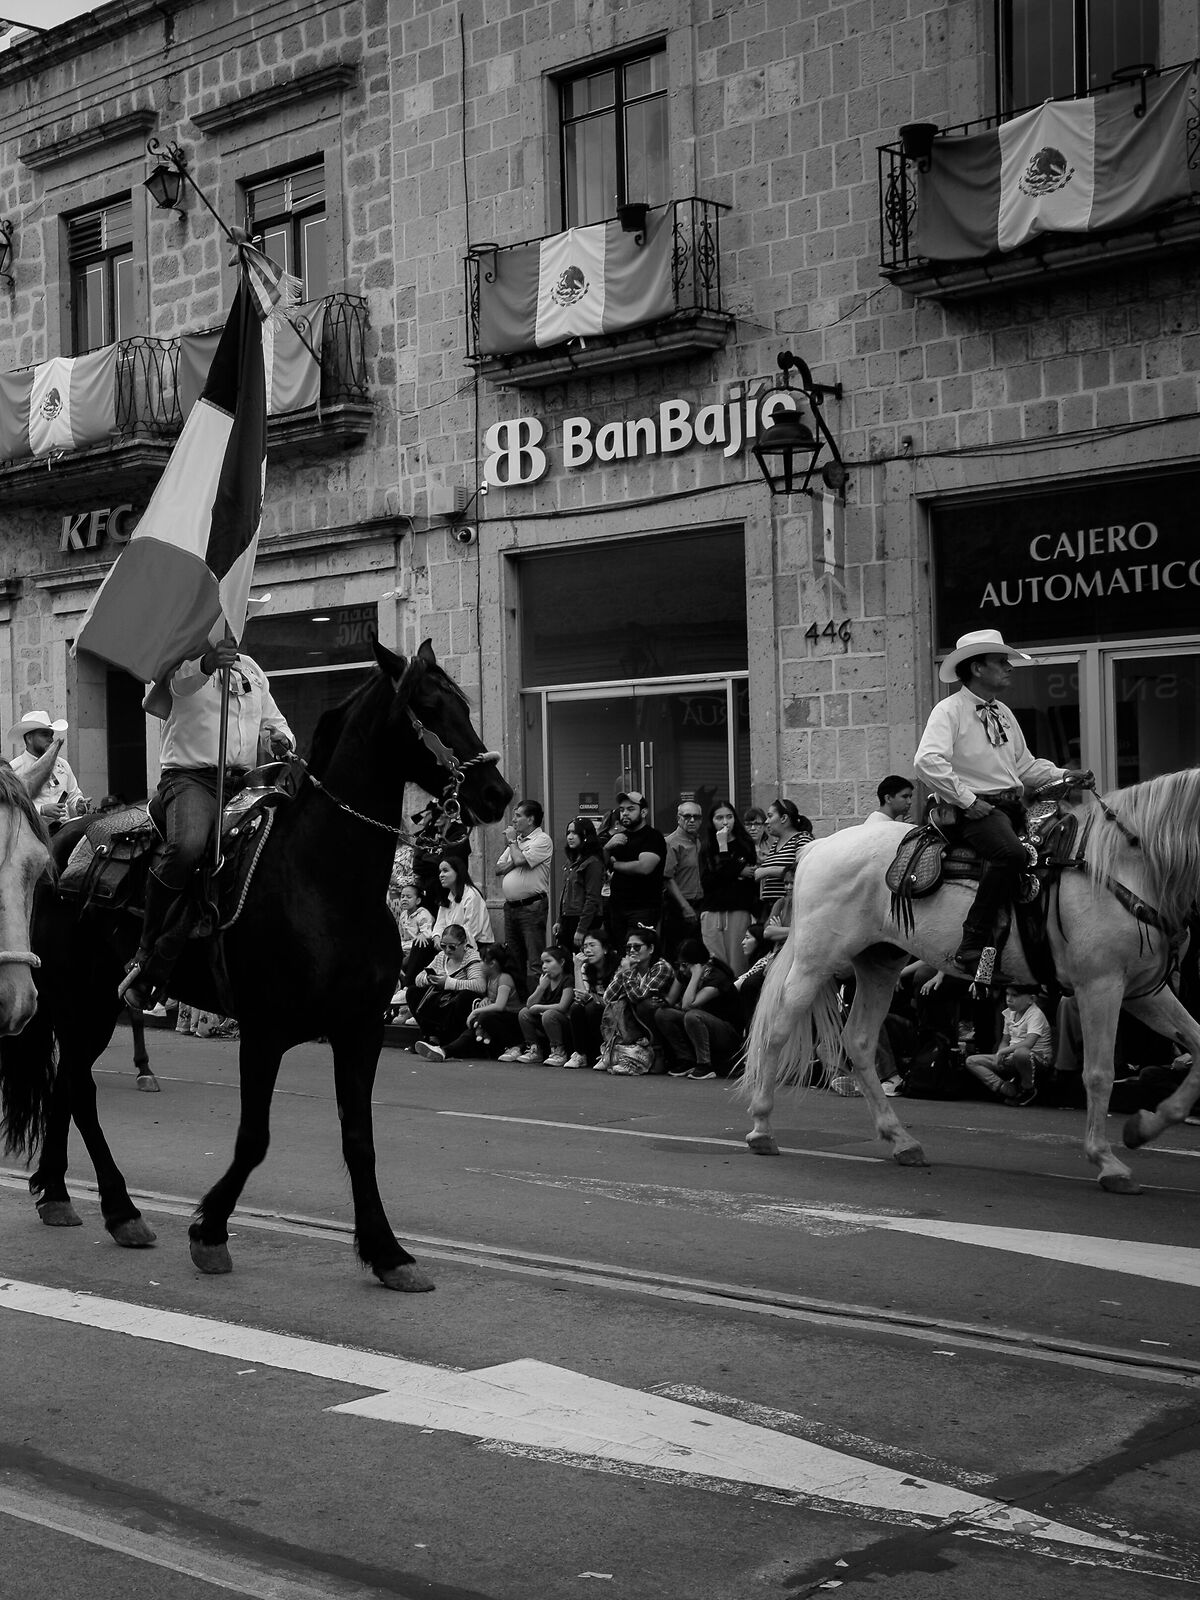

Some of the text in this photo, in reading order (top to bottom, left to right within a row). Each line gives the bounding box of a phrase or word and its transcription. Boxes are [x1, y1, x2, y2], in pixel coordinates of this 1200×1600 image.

[57, 503, 133, 552] KFC
[1029, 520, 1159, 563] CAJERO
[804, 617, 852, 646] 446
